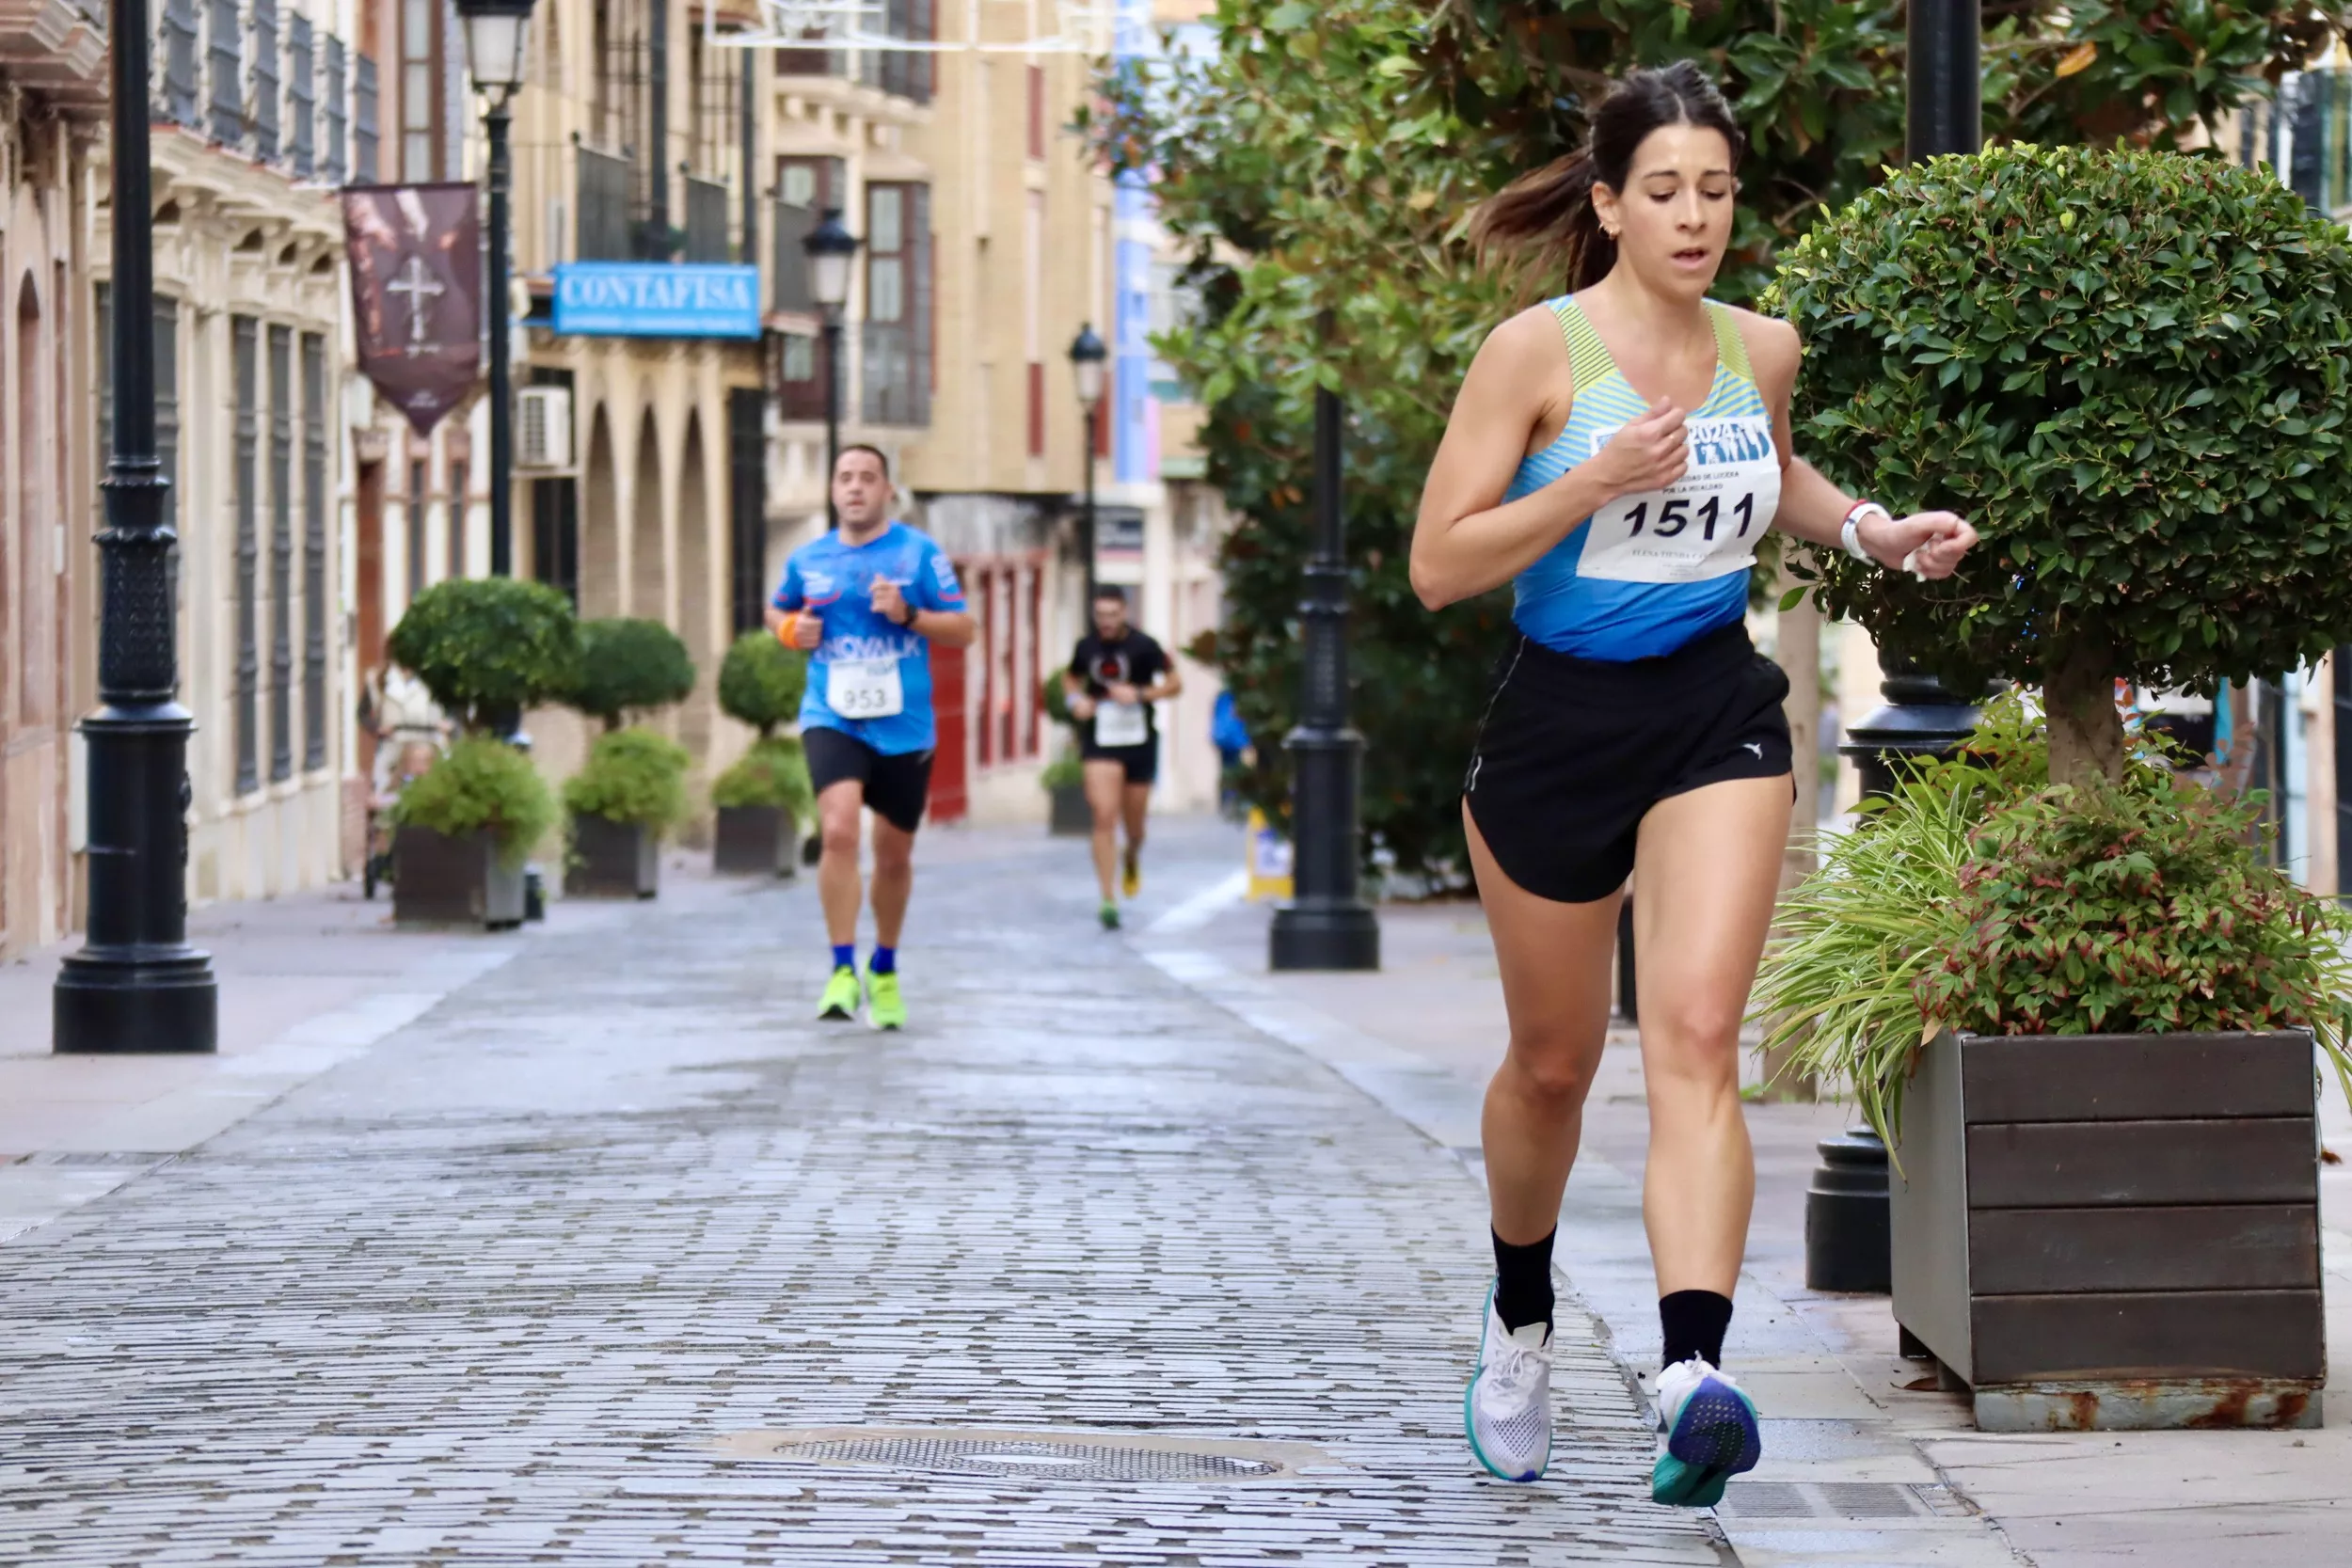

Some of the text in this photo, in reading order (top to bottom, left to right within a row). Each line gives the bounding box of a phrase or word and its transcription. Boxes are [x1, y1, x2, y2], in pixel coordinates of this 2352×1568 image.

[561, 276, 751, 309] CONTAFISA
[1624, 492, 1754, 541] 1511
[844, 689, 886, 710] 953
